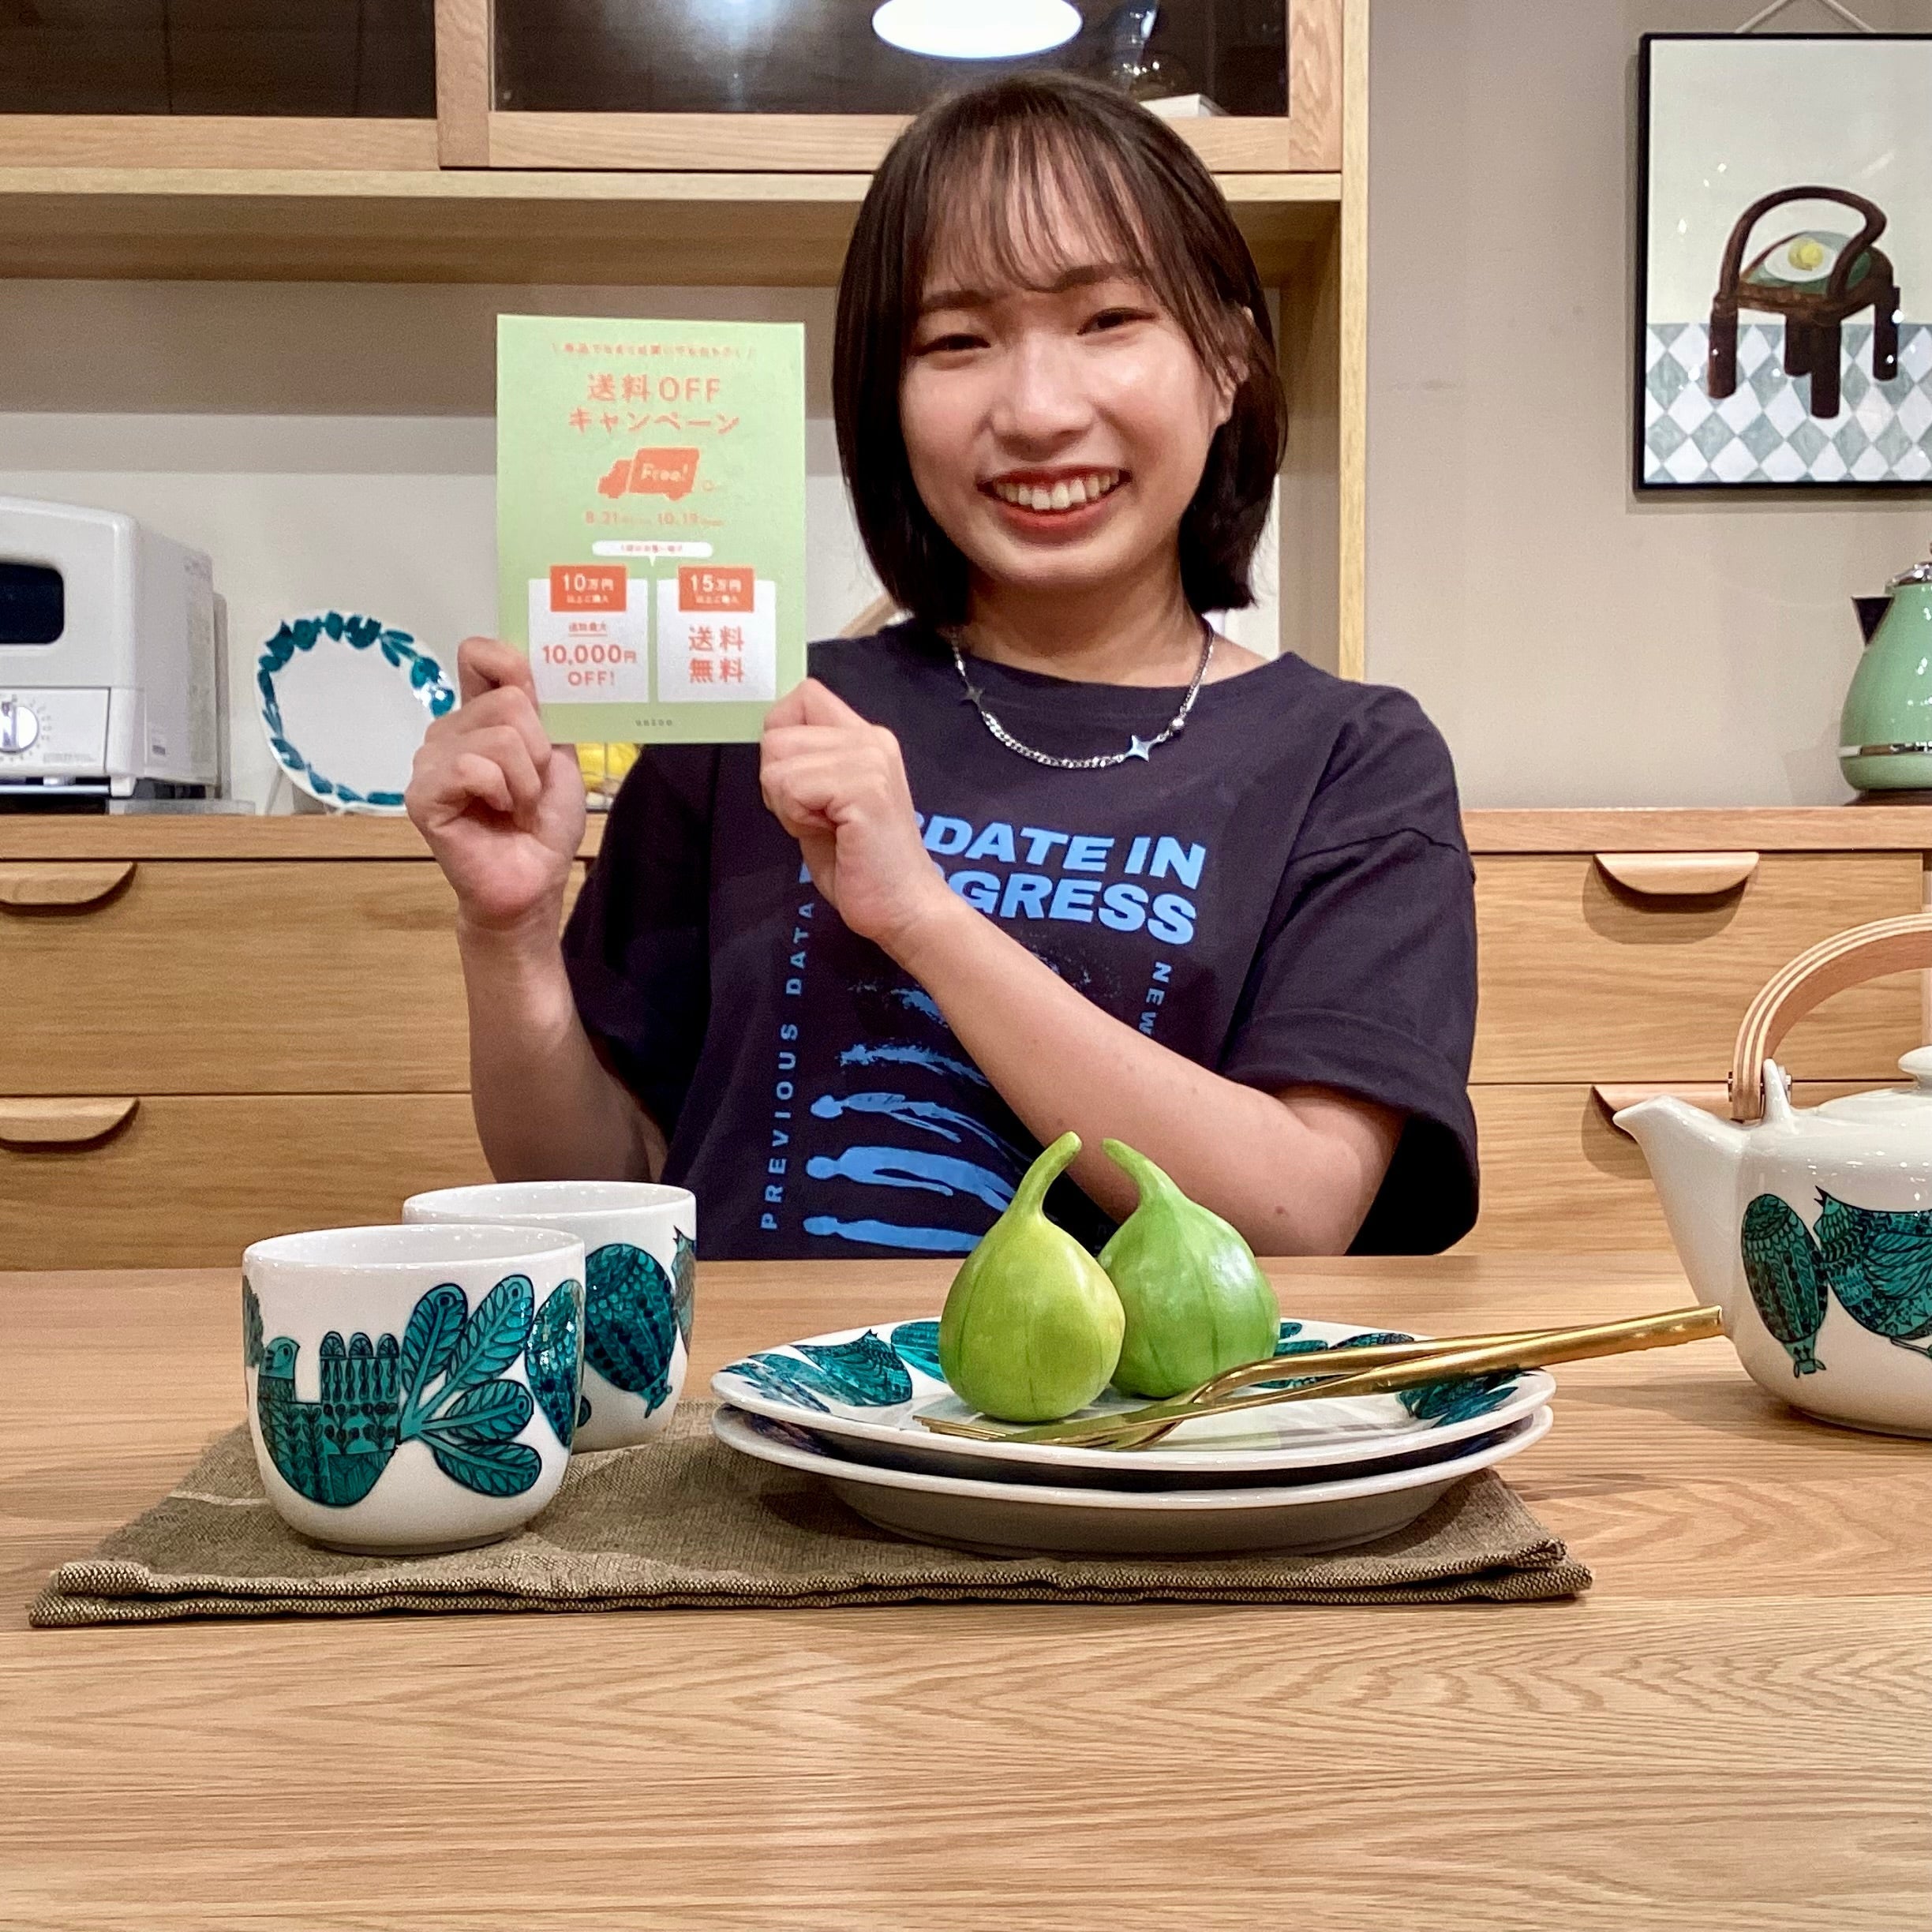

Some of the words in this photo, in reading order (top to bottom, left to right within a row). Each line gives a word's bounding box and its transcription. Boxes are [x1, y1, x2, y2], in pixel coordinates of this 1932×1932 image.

[587, 373, 721, 402] 送料OFF
[569, 406, 739, 433] キャンペーン
[641, 463, 687, 482] Free!
[563, 574, 614, 592] 10万円
[691, 574, 742, 593] 15万円
[688, 626, 744, 652] 送料
[542, 645, 637, 665] 10,000円
[567, 671, 615, 686] OFF!
[689, 658, 744, 683] 無料
[914, 811, 1114, 871] DATE
[1124, 837, 1205, 889] IN
[933, 862, 1196, 945] GRESS
[1139, 961, 1172, 1035] NEW
[760, 1024, 799, 1230] PREVIOUS
[785, 902, 815, 995] DATA
